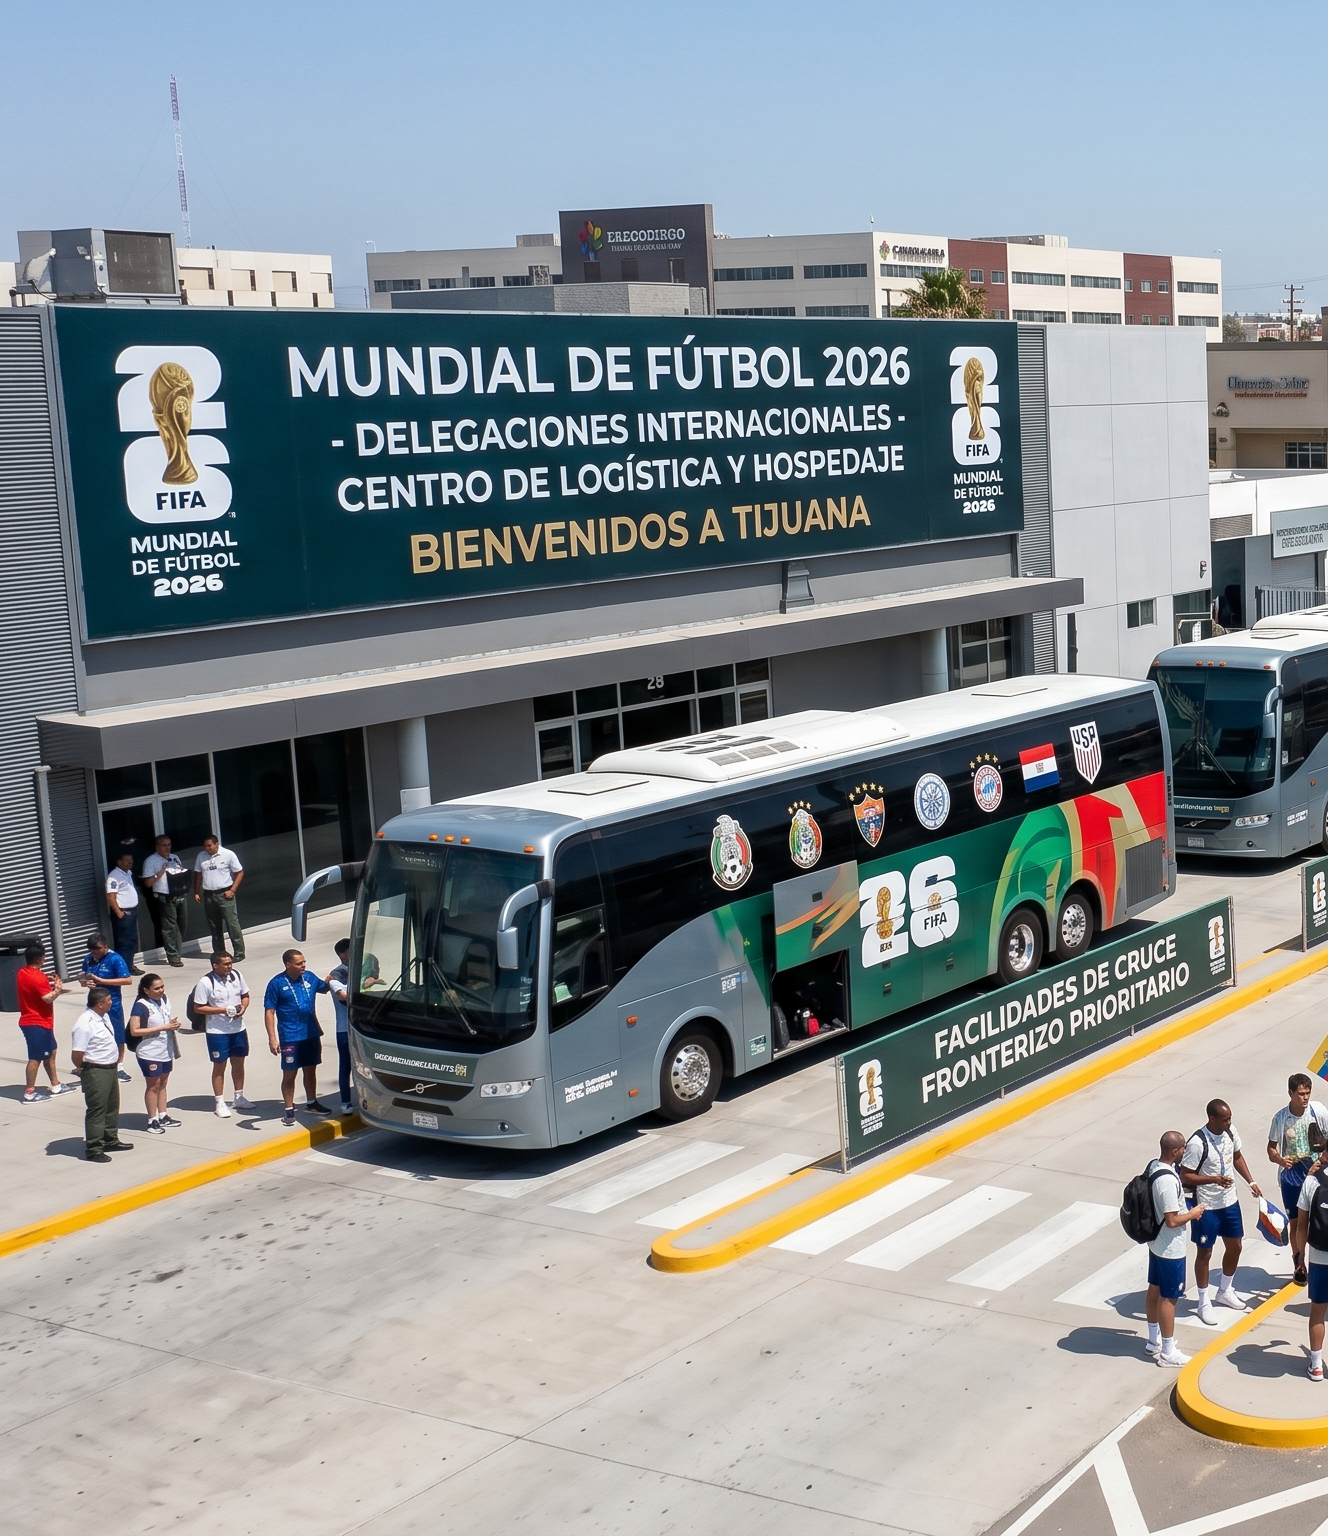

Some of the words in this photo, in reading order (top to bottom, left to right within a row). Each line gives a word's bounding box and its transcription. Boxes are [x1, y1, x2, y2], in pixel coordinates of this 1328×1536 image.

[288, 346, 555, 398] MUNDIAL
[568, 346, 634, 391] DE
[647, 334, 814, 391] FÚTBOL
[822, 346, 911, 387] 2026
[356, 413, 629, 457] DELEGACIONES
[637, 404, 892, 443] INTERNACIONALES
[965, 443, 990, 458] FIFA
[337, 470, 493, 512] CENTRO
[503, 466, 550, 500] DE
[559, 453, 722, 496] LOGÍSTICA
[726, 454, 745, 484] Y
[753, 445, 905, 482] HOSPEDAJE
[953, 470, 1004, 486] MUNDIAL
[156, 490, 207, 511] FIFA
[954, 487, 967, 500] DE
[968, 485, 1004, 499] FÚTBOL
[962, 498, 996, 515] 2026
[130, 530, 238, 554] MUNDIAL
[410, 510, 690, 574] BIENVENIDOS
[699, 507, 725, 544] A
[731, 494, 872, 540] TIJUANA
[131, 558, 160, 576] DE
[164, 551, 240, 573] FÚTBOL
[153, 573, 224, 597] 2026
[647, 675, 665, 690] 28
[859, 855, 960, 969] 26
[933, 975, 1078, 1061] FACILIDADES
[1083, 961, 1110, 996] DE
[1114, 933, 1178, 981] CRUCE
[921, 1018, 1065, 1104] FRONTERIZO
[1069, 962, 1190, 1038] PRIORITARIO
